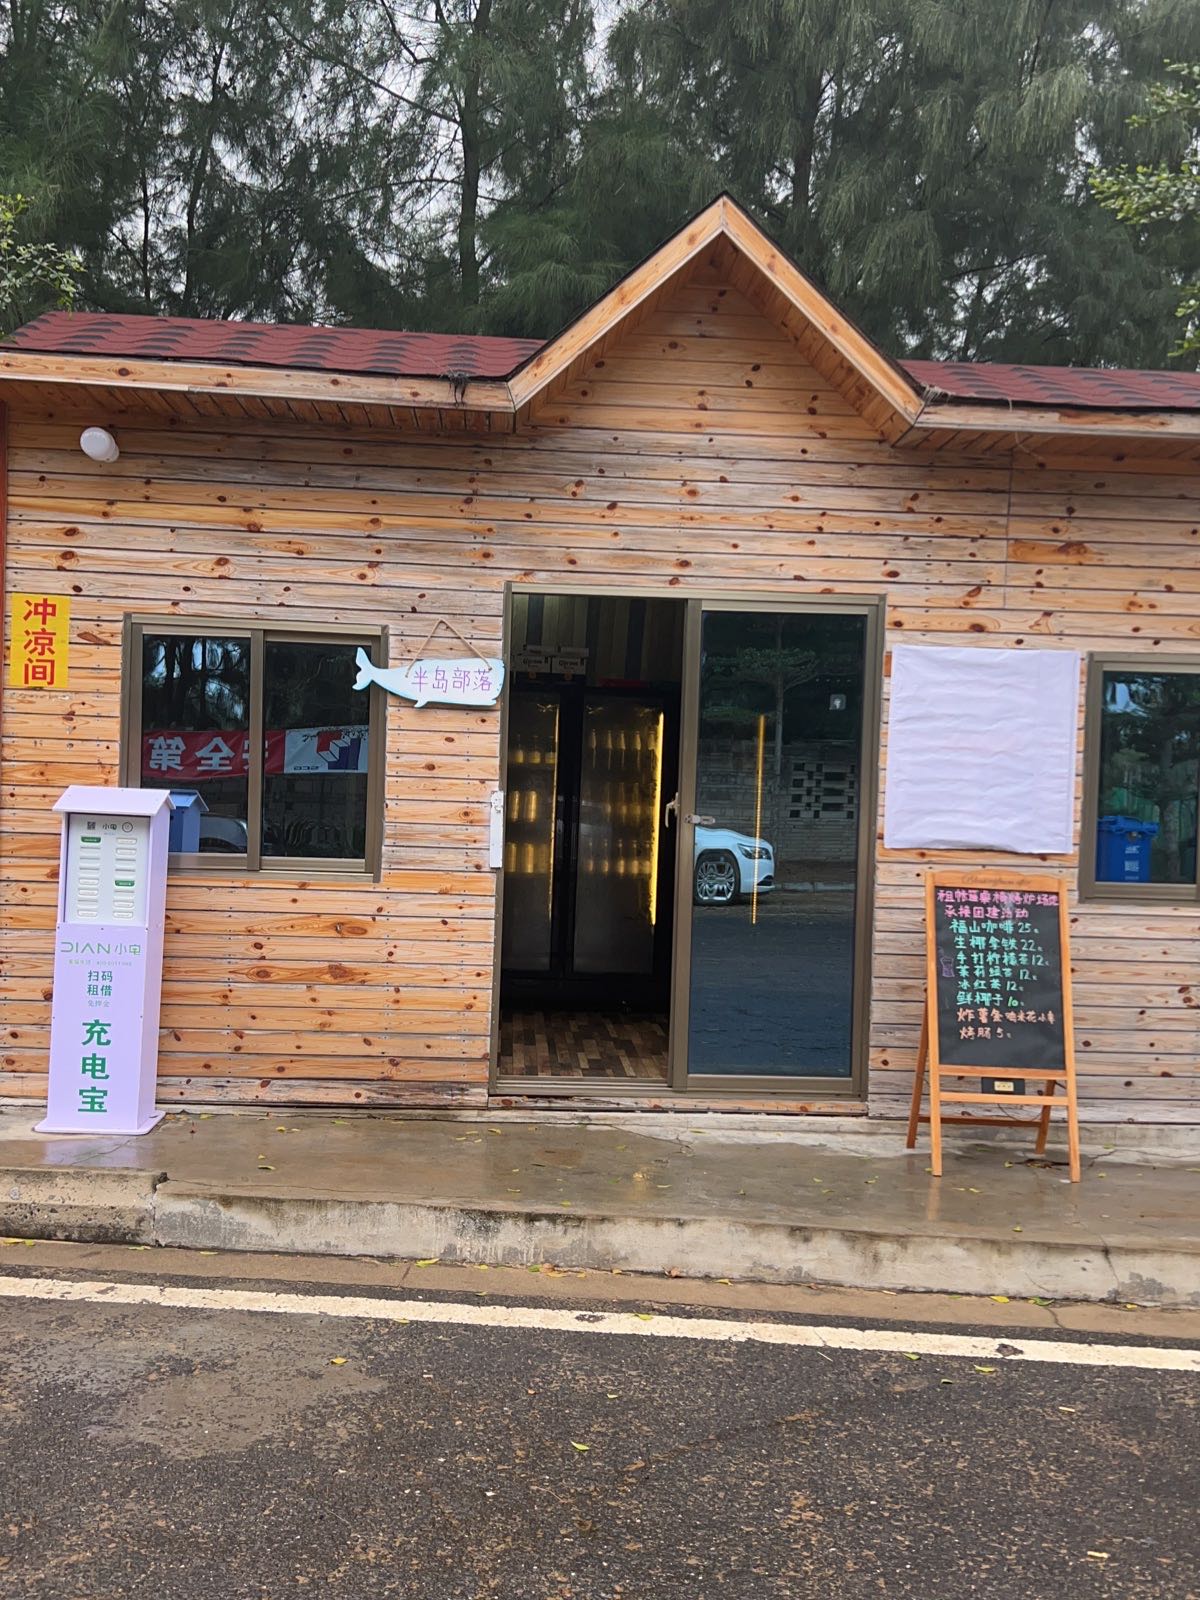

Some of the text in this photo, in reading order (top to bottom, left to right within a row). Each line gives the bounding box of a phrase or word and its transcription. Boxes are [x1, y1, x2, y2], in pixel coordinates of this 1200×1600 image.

[23, 597, 57, 686] 冲凉间
[410, 665, 493, 693] 半岛部落
[949, 919, 1014, 934] 福山咖啡
[954, 936, 1019, 951] 生椰拿铁
[87, 970, 113, 982] 扫码
[87, 984, 113, 996] 租借
[958, 979, 1002, 991] 冰红茶
[956, 991, 1004, 1006] 鲜椰子
[959, 1026, 992, 1040] 烤肠
[77, 1019, 112, 1113] 充电宝
